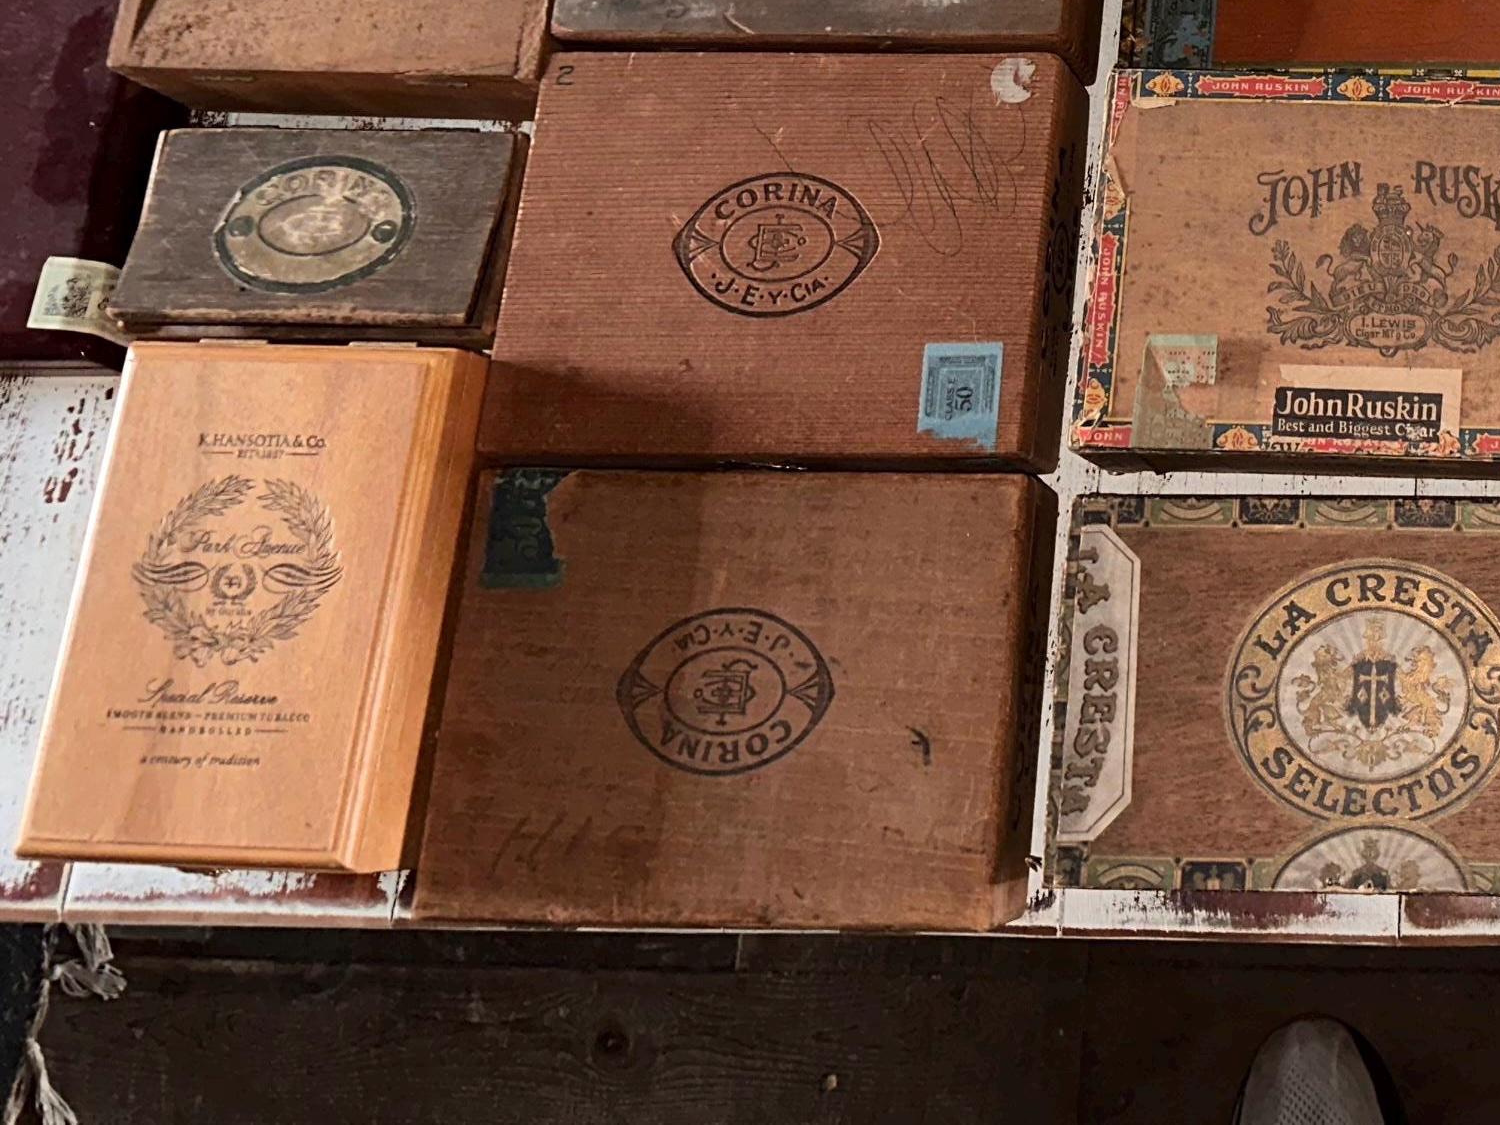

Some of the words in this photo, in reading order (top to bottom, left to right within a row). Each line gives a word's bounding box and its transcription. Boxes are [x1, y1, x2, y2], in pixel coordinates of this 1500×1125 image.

[555, 65, 575, 86] 2
[1211, 81, 1250, 92] JOHN
[1254, 82, 1310, 93] RUSKIN
[1403, 85, 1442, 96] JOHN
[713, 181, 841, 223] CORINA
[1249, 161, 1362, 236] JOHN
[1371, 318, 1417, 329] LEWIS
[954, 385, 974, 413] 50
[1277, 390, 1344, 417] John
[1347, 392, 1437, 421] Ruskin
[1277, 418, 1305, 433] Best
[1308, 420, 1335, 434] and
[1338, 421, 1391, 438] Biggest
[179, 529, 237, 555] Park
[236, 526, 307, 559] Avenue
[1075, 544, 1111, 614] LA
[1253, 598, 1317, 662] LA
[1326, 573, 1494, 667] CRESTA
[138, 678, 209, 708] Special
[209, 680, 279, 705] Reserve
[1060, 623, 1120, 819] CRESTA
[658, 717, 795, 768] CORINA
[1261, 744, 1482, 819] SELECTOS
